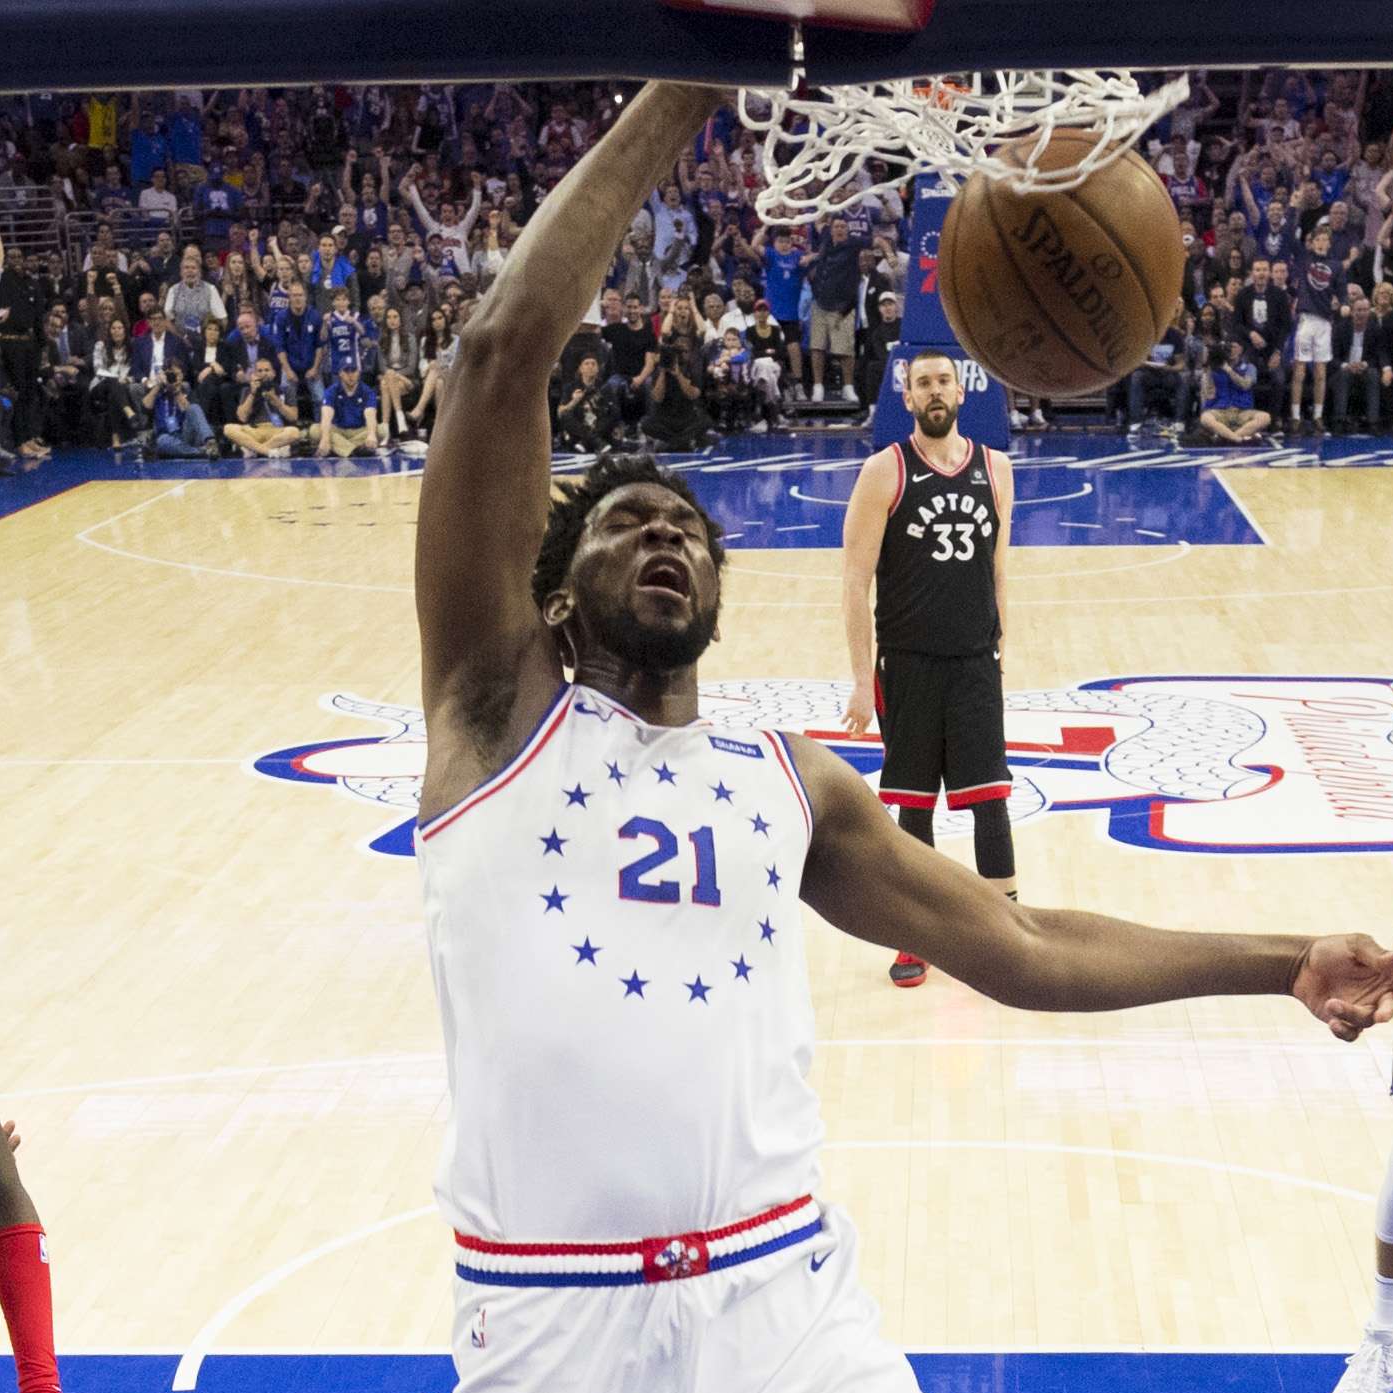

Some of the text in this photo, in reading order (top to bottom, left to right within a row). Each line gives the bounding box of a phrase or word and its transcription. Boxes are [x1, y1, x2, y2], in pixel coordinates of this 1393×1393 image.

[907, 492, 993, 539] RAPTORS
[931, 523, 975, 562] 33
[618, 816, 721, 907] 21
